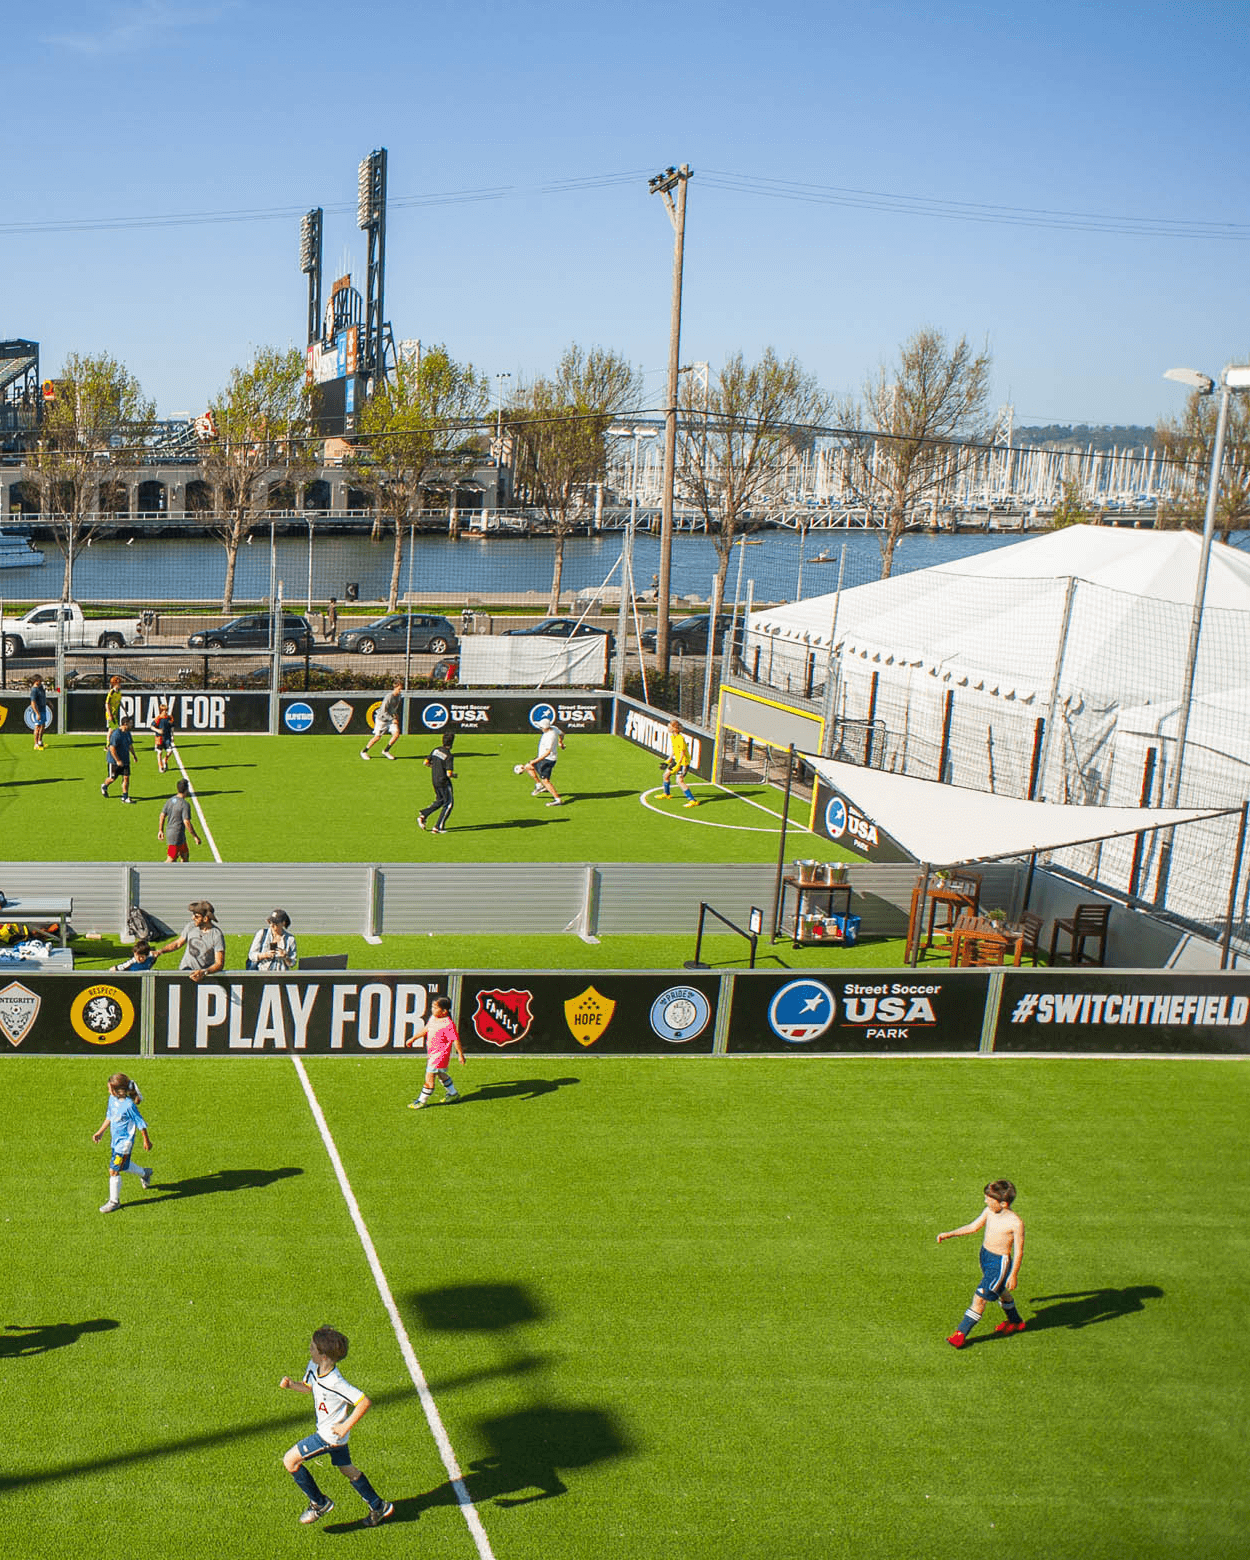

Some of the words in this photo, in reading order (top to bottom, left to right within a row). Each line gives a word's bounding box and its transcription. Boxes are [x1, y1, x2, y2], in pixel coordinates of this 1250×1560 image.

[450, 710, 490, 721] USA
[558, 710, 596, 721] USA
[848, 815, 879, 845] USA
[87, 986, 118, 996] RESPECT
[844, 984, 889, 994] Street
[890, 984, 942, 994] Soccer
[666, 990, 687, 1002] PRIDE
[842, 997, 937, 1022] USA
[1011, 993, 1250, 1025] #SWITCHTHEFIELD
[167, 984, 181, 1049] I
[196, 984, 320, 1049] PLAY
[330, 984, 428, 1049] FOR
[486, 999, 518, 1034] FAMILY
[574, 1014, 603, 1025] HOPE
[866, 1029, 909, 1038] PARK
